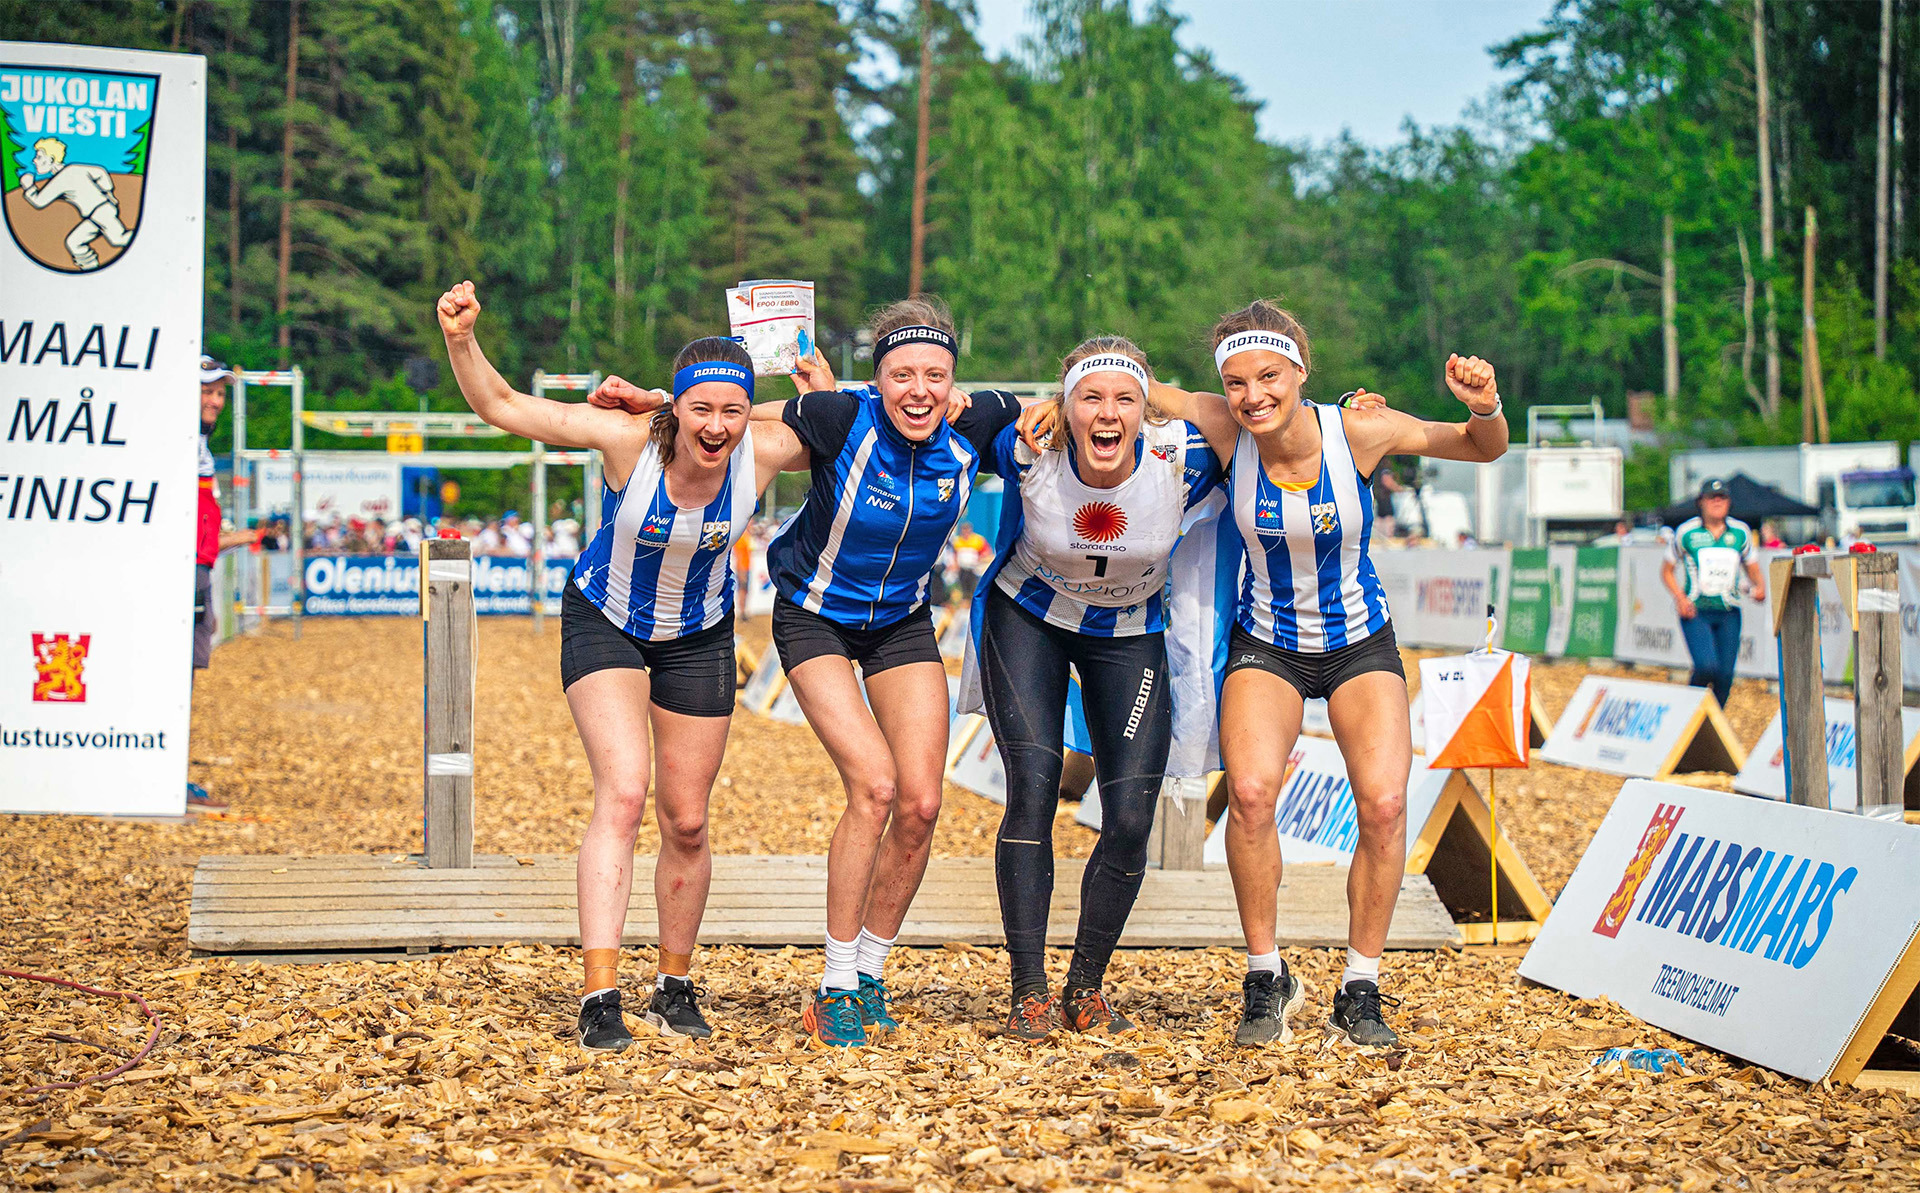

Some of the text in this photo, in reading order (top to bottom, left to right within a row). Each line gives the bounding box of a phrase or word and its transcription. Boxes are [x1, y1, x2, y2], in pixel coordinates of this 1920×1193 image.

[0, 75, 147, 111] JUKOLAN
[22, 105, 126, 138] VIESTI
[888, 329, 949, 345] noname
[1227, 335, 1290, 351] noname
[693, 367, 746, 379] noname
[1081, 358, 1144, 379] noname
[7, 387, 127, 446] MÅL
[0, 475, 158, 523] INISH
[867, 485, 901, 501] noname
[1085, 555, 1108, 578] 1
[1123, 667, 1154, 740] noname
[1636, 833, 1859, 969] MARSMARS
[1650, 964, 1740, 1017] TREENIOHJELMAT
